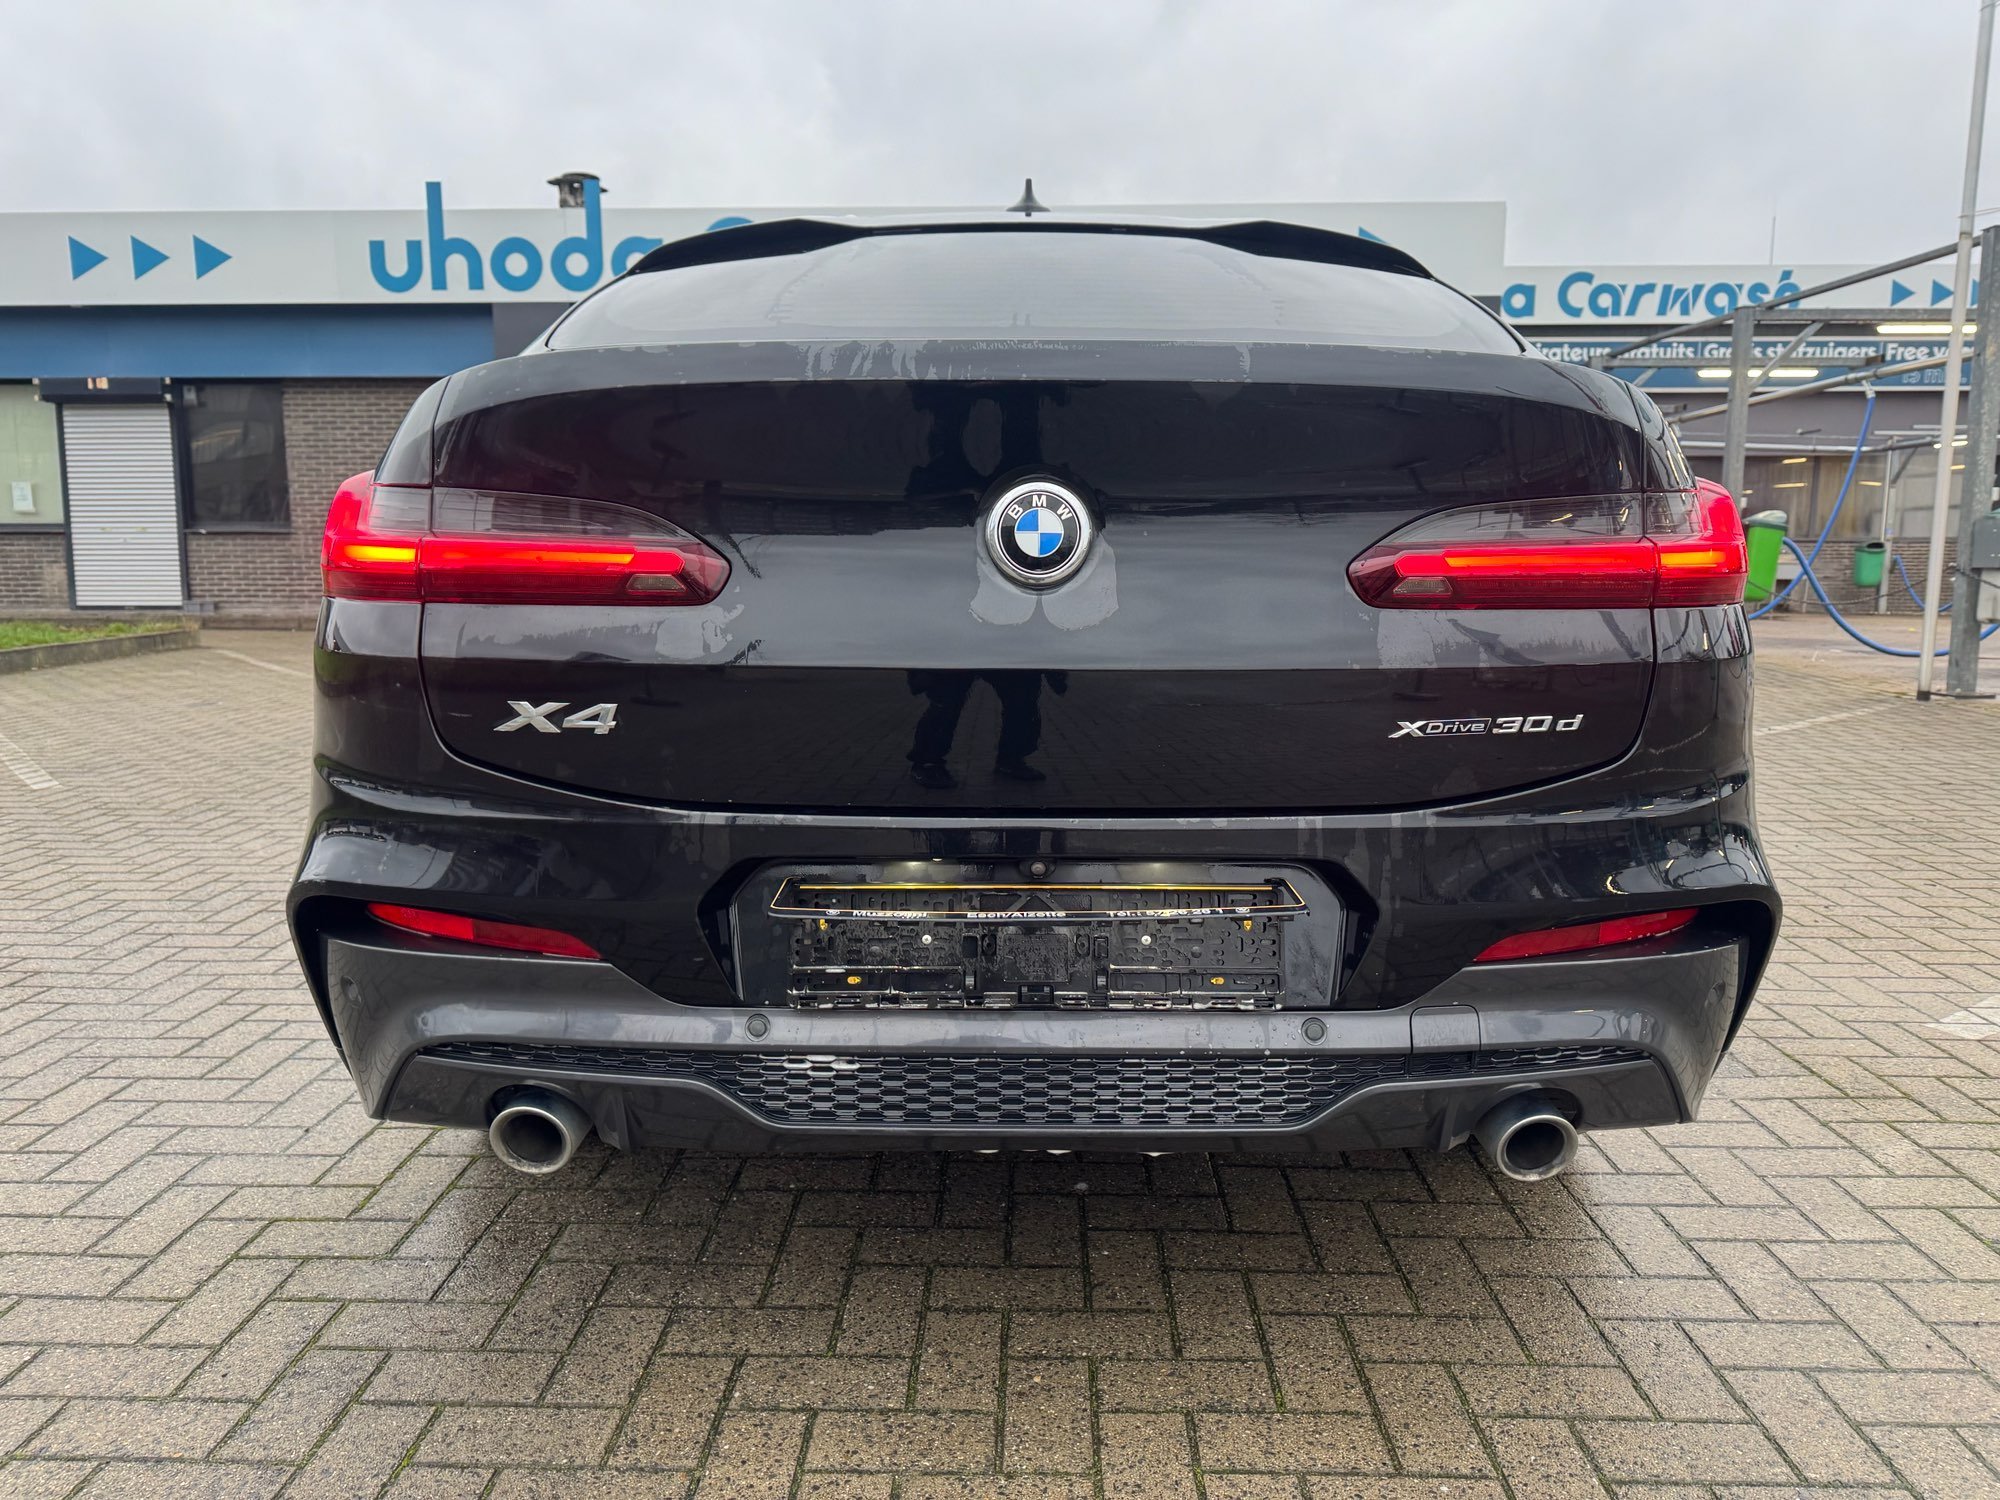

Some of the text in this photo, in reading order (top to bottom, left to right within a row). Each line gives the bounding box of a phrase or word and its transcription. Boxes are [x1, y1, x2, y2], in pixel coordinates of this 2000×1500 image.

[1557, 269, 1802, 318] Carwash
[1617, 342, 1695, 359] ratuits
[1766, 341, 1877, 359] stfzuigers
[1885, 342, 1930, 361] Free
[1007, 494, 1073, 520] BMW
[493, 700, 618, 734] X4
